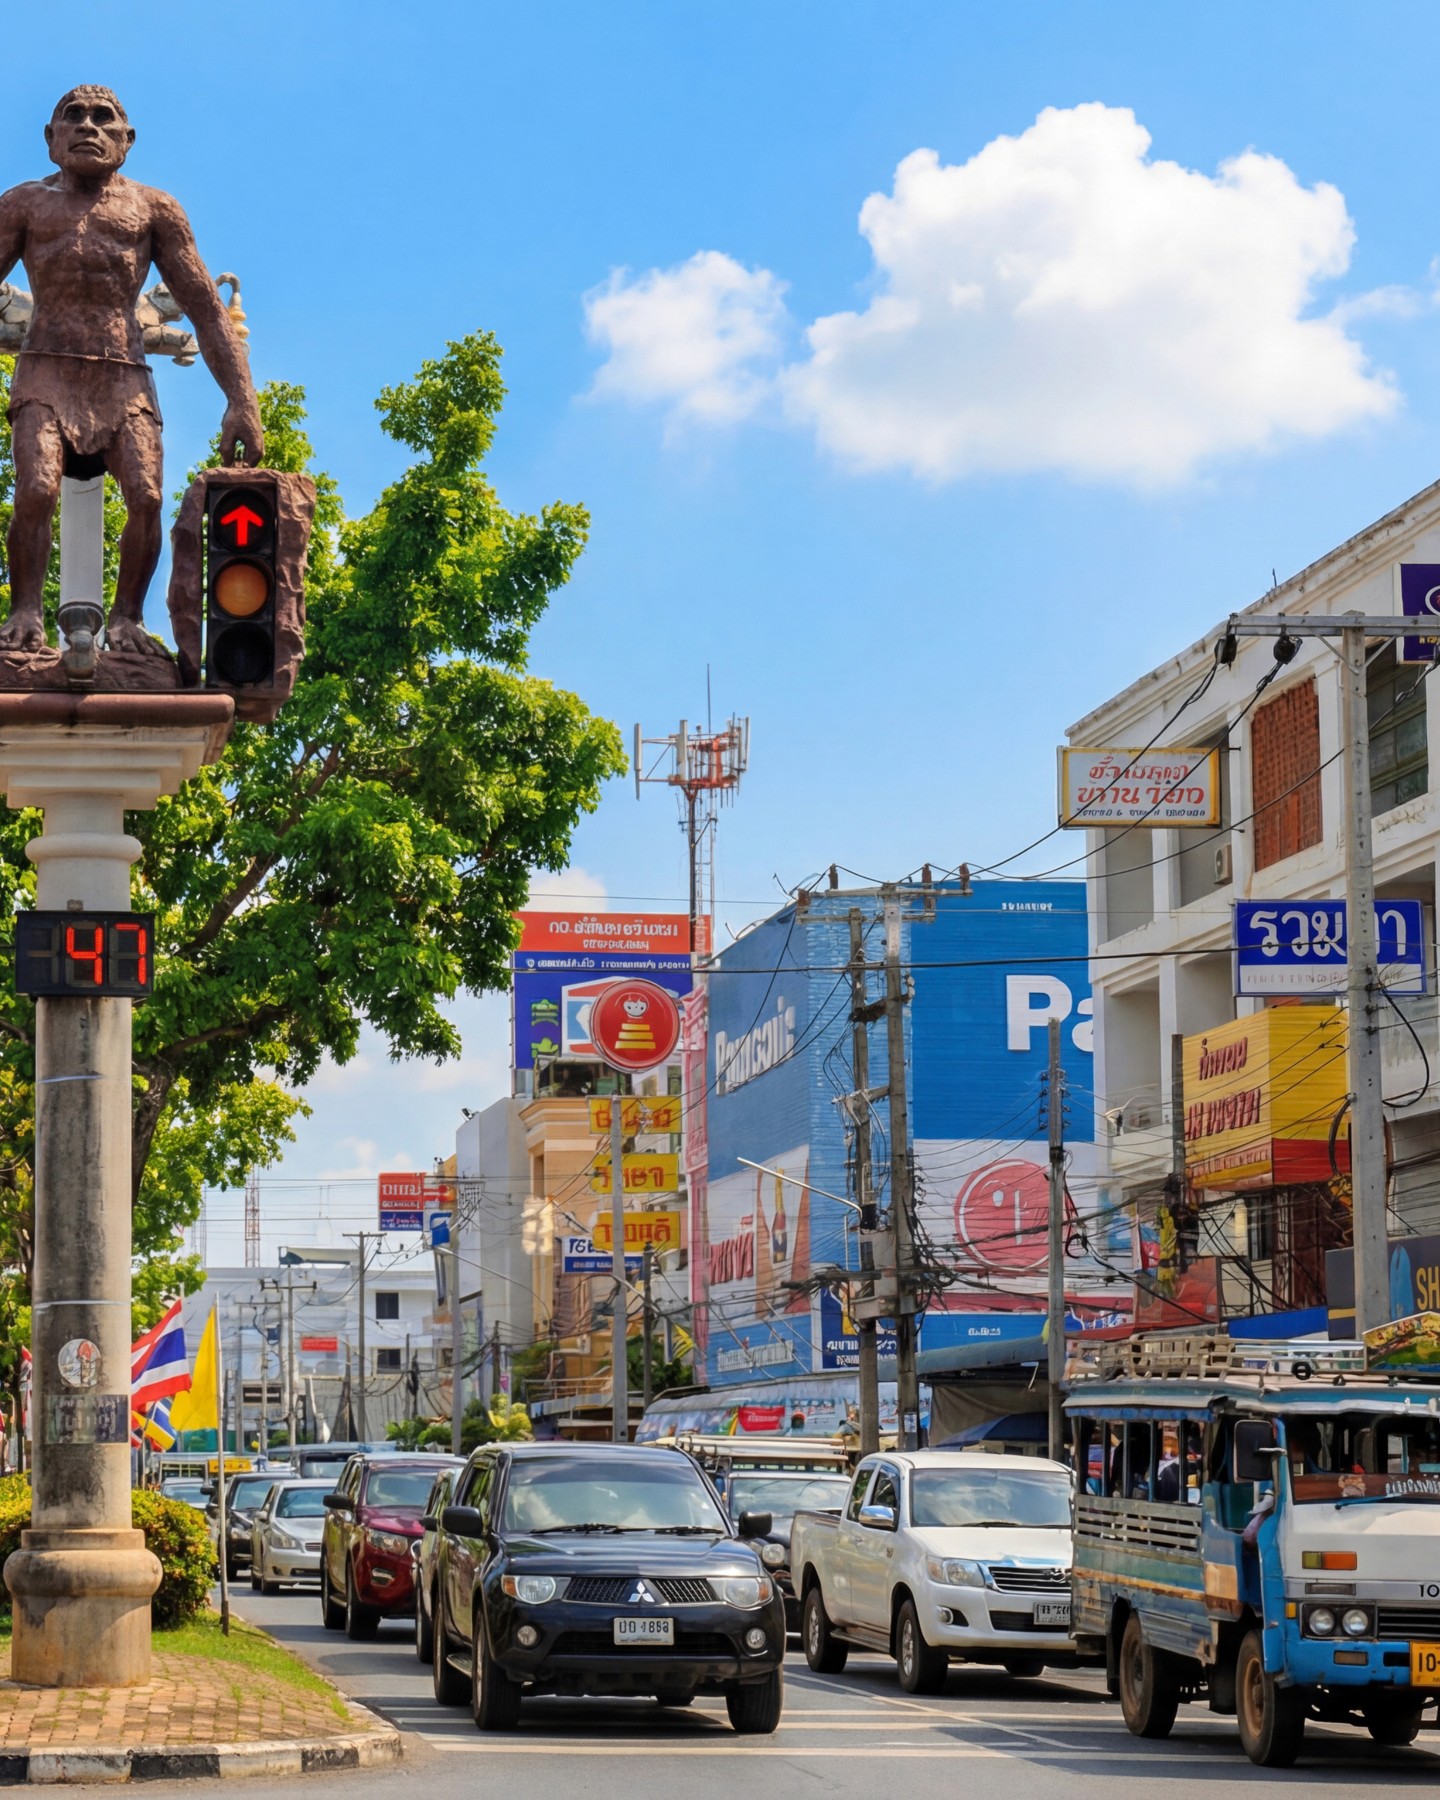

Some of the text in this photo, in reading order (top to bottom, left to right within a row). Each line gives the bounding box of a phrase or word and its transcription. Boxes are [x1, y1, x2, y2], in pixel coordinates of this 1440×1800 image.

[65, 922, 147, 986] 47
[1249, 909, 1407, 958] รวมา
[1416, 1266, 1440, 1311] SH
